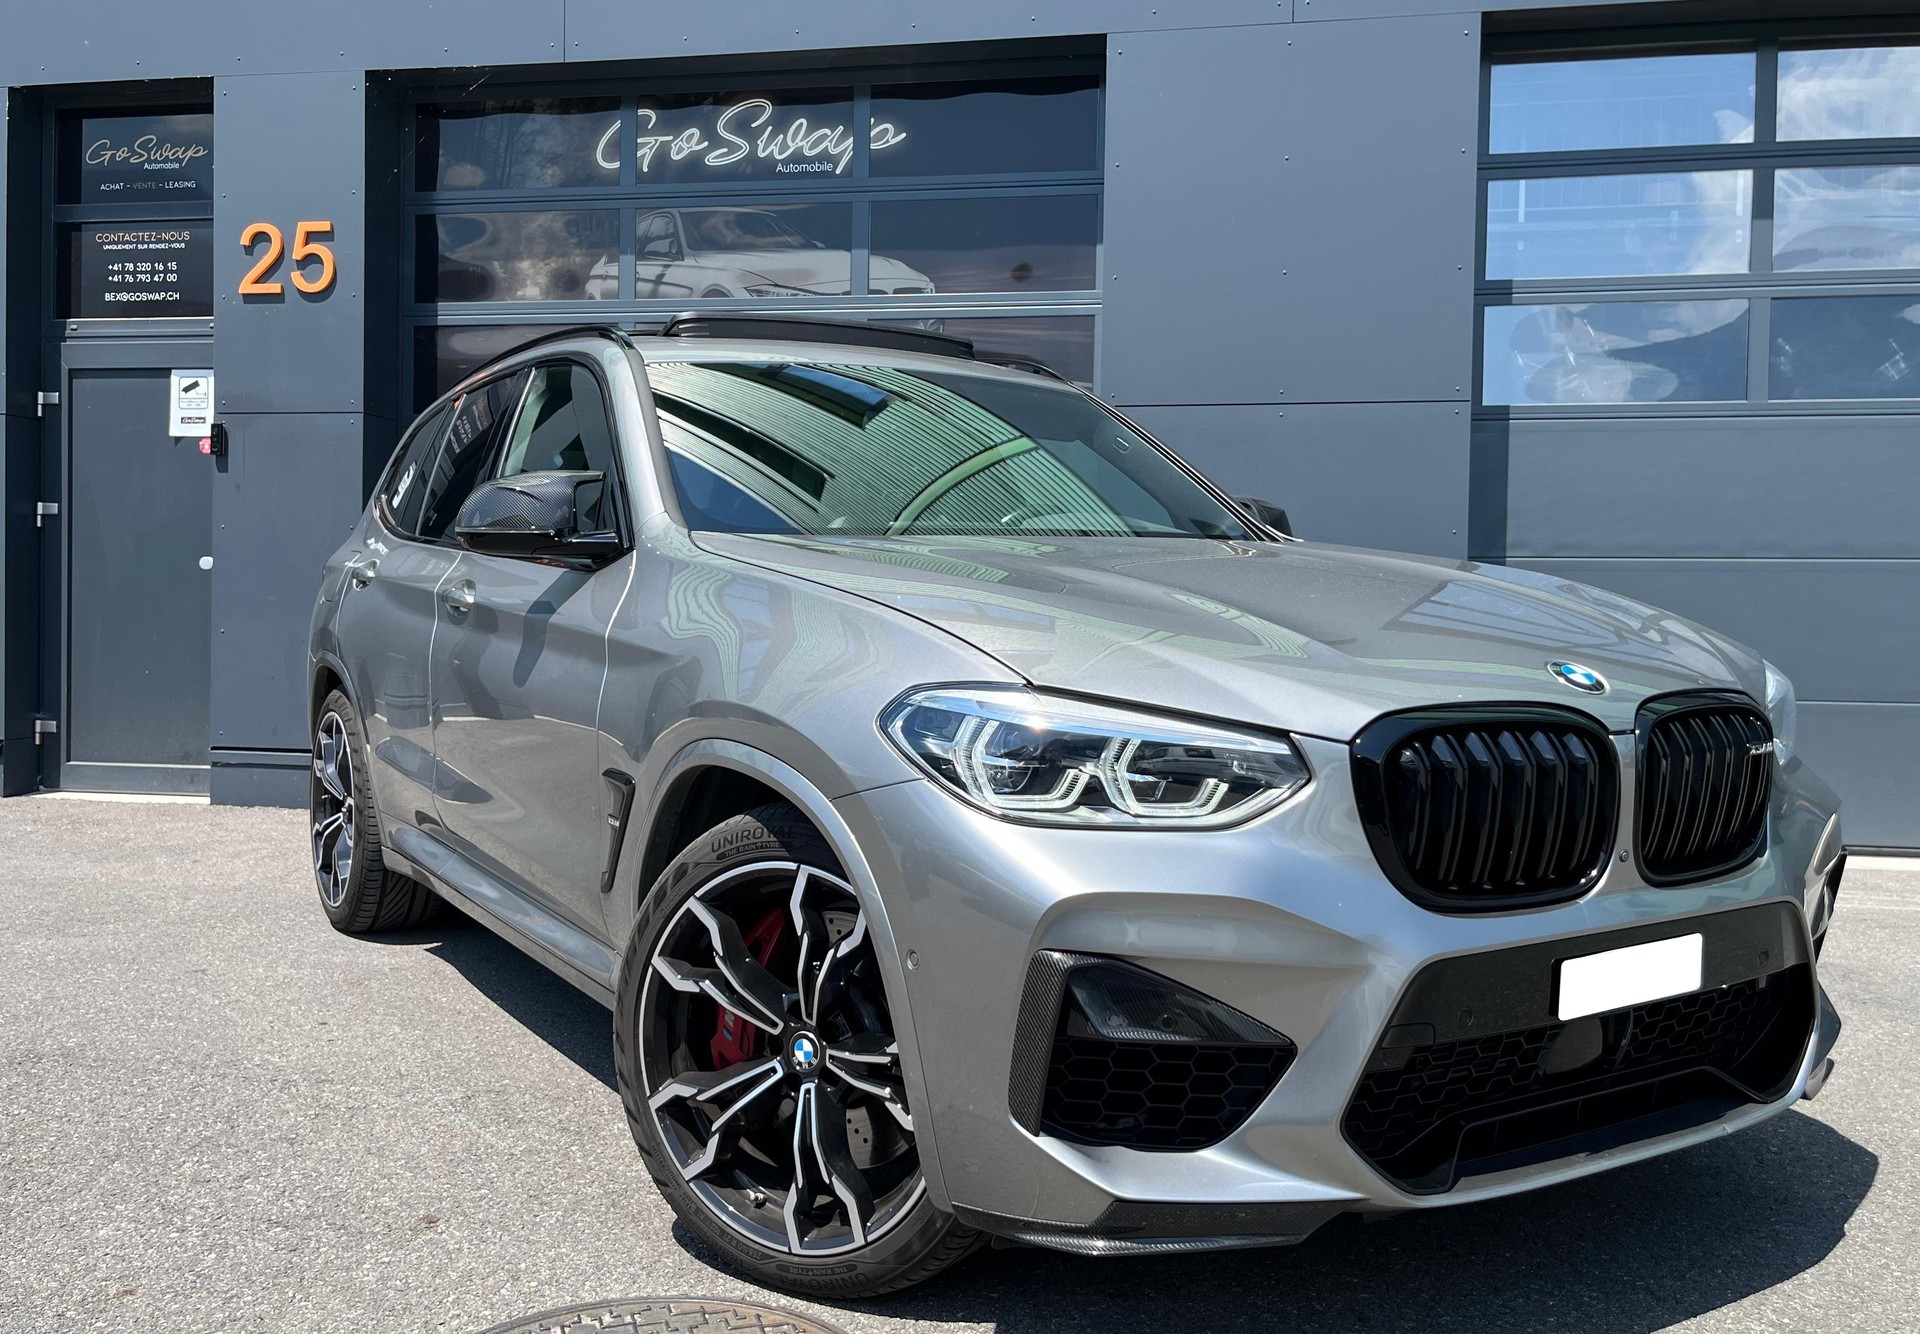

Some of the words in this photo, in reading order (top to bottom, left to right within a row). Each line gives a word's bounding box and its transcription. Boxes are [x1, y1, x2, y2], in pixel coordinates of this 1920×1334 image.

[596, 97, 907, 175] GoSwap
[86, 134, 209, 167] GoSwap
[143, 161, 180, 170] Automobile
[776, 160, 834, 173] Automobile
[100, 182, 124, 191] ACHAT
[132, 181, 157, 190] VENTE
[164, 180, 197, 189] LEASING
[95, 231, 191, 243] CONTACTEZ-NOUS
[238, 220, 336, 295] 25
[108, 263, 122, 272] +41
[124, 262, 134, 272] 78
[136, 262, 152, 271] 320
[154, 262, 164, 271] 16
[167, 261, 178, 270] 15
[108, 274, 122, 283] +41
[124, 274, 134, 283] 76
[136, 274, 151, 283] 793
[153, 273, 164, 282] 47
[166, 273, 178, 282] 00
[104, 291, 180, 301] BEX@GOSWAP.CH
[724, 847, 738, 857] THE
[739, 843, 756, 853] RAIN
[762, 841, 780, 849] TYRE
[738, 1243, 762, 1260] 255/40
